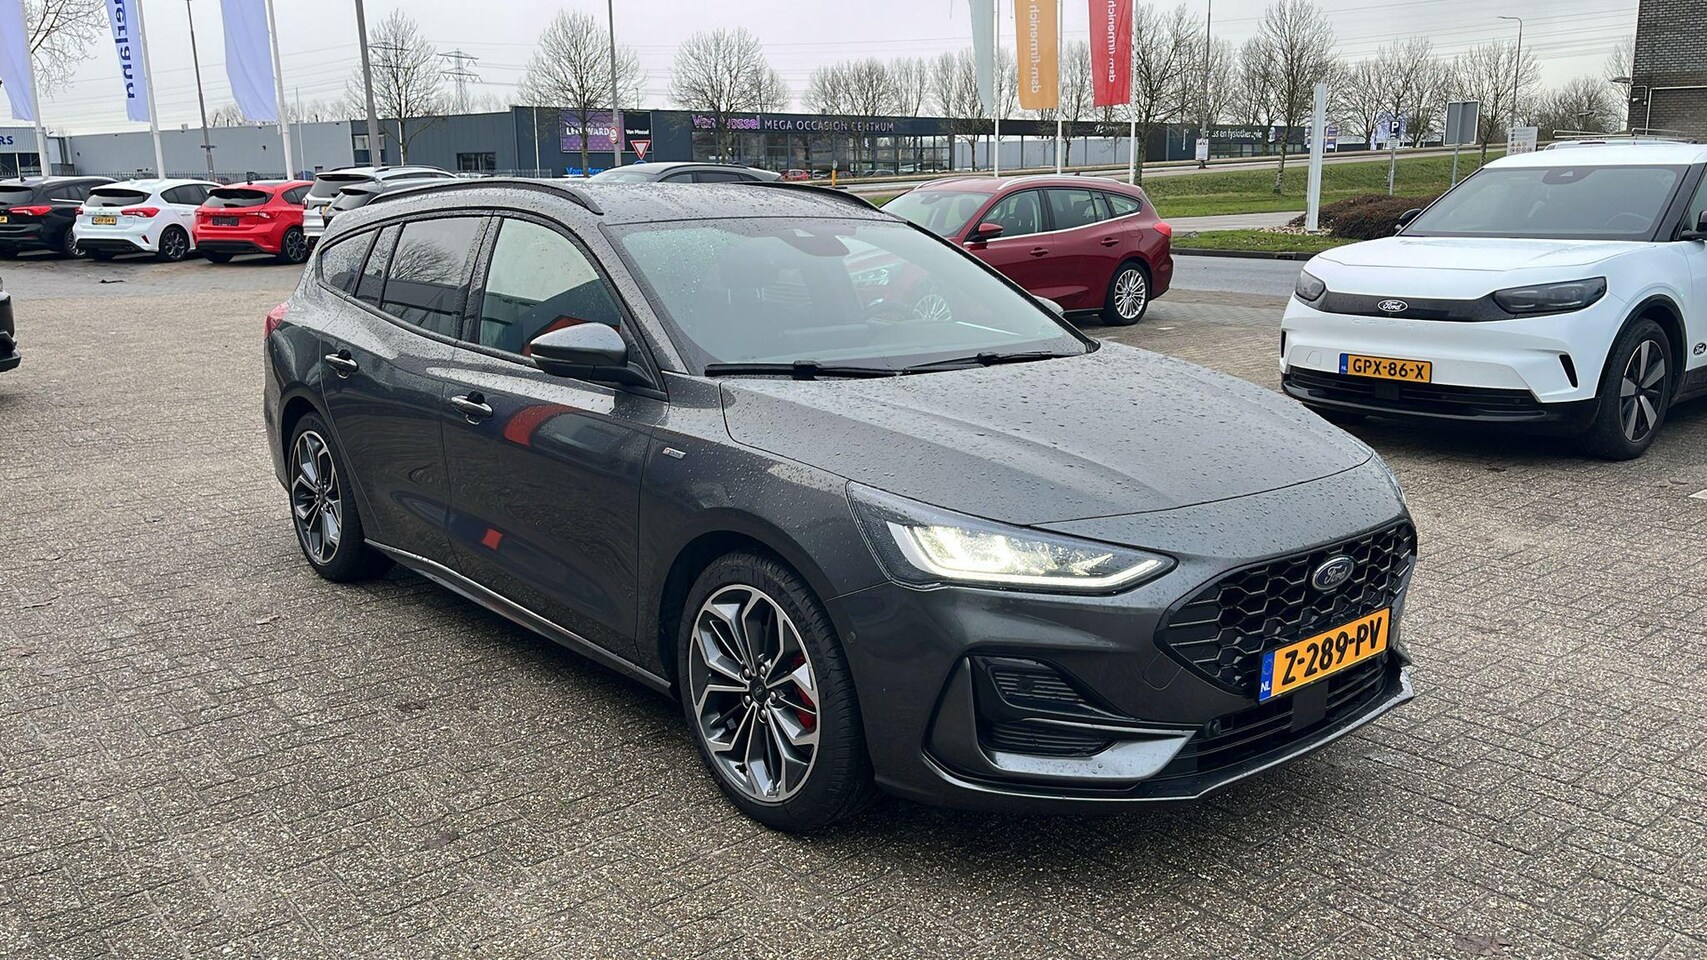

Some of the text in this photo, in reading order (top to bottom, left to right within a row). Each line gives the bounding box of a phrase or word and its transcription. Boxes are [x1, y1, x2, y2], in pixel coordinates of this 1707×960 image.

[692, 113, 717, 129] Van
[720, 115, 760, 130] ossel
[764, 120, 793, 130] MEGA
[796, 120, 848, 131] OCCASION
[1391, 121, 1400, 133] P
[1381, 300, 1404, 311] Ford
[1352, 358, 1425, 380] GPX-86-X
[1260, 616, 1382, 693] NL Z-289-PV
